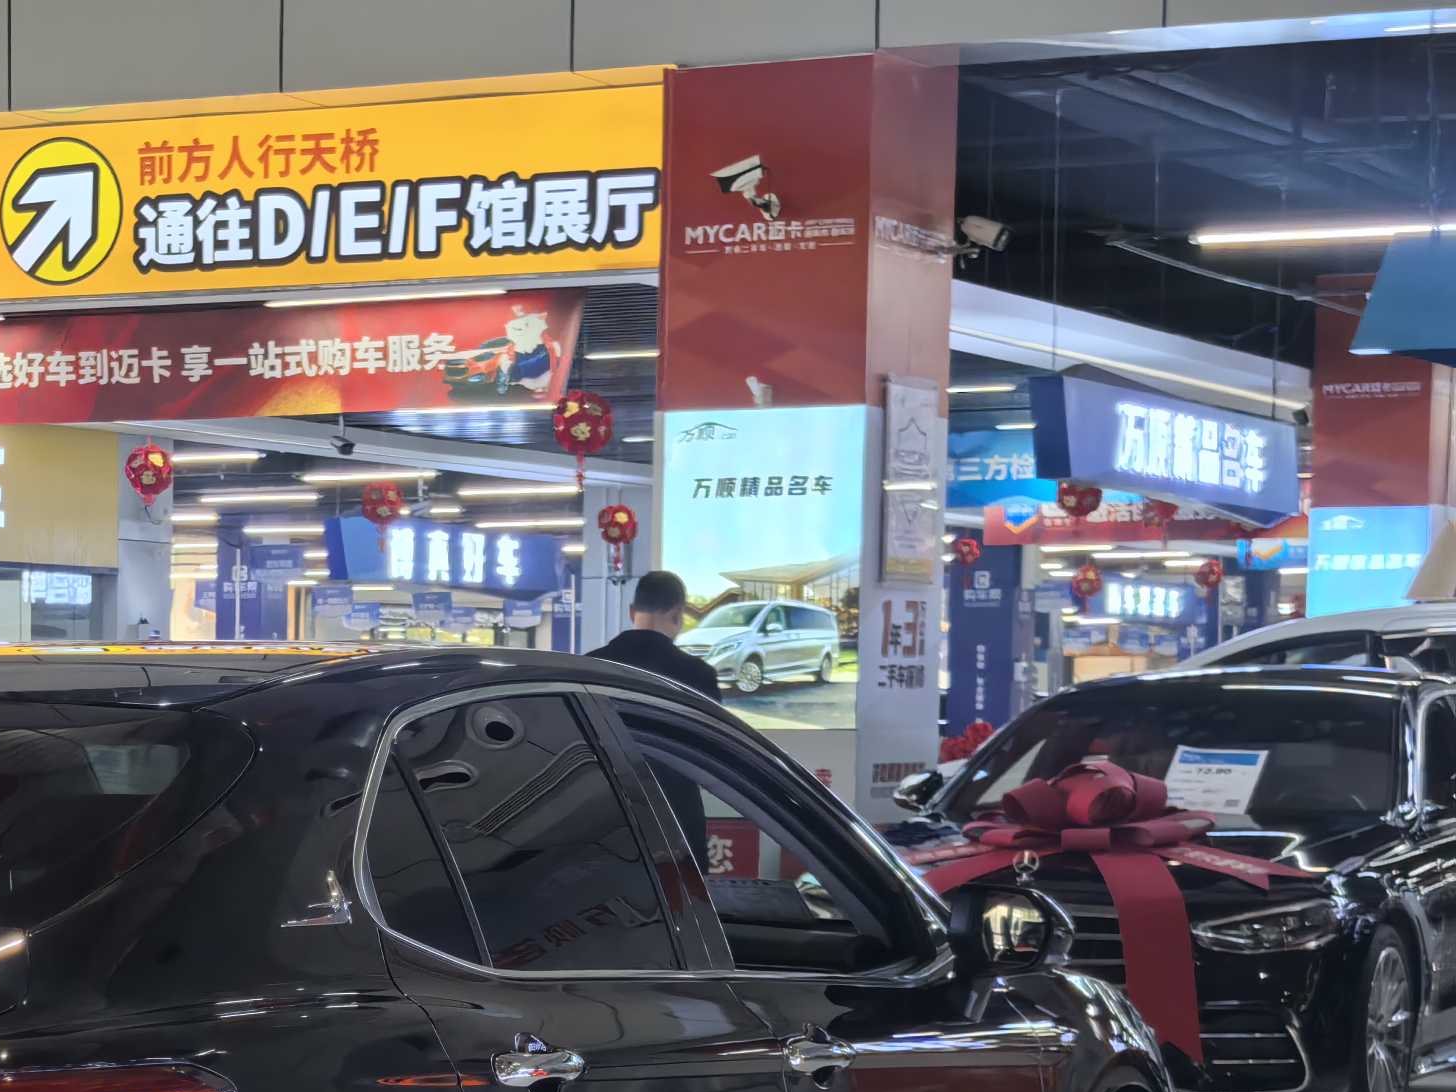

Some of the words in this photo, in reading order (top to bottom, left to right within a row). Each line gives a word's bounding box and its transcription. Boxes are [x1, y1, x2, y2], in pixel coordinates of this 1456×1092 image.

[137, 128, 379, 185] 前方人行天桥
[138, 172, 657, 269] 通往D/E/F馆展厅
[180, 331, 458, 378] 享一站式购车服务
[1114, 401, 1269, 494] 万顺精品名车
[692, 474, 834, 499] 万顺精品名车
